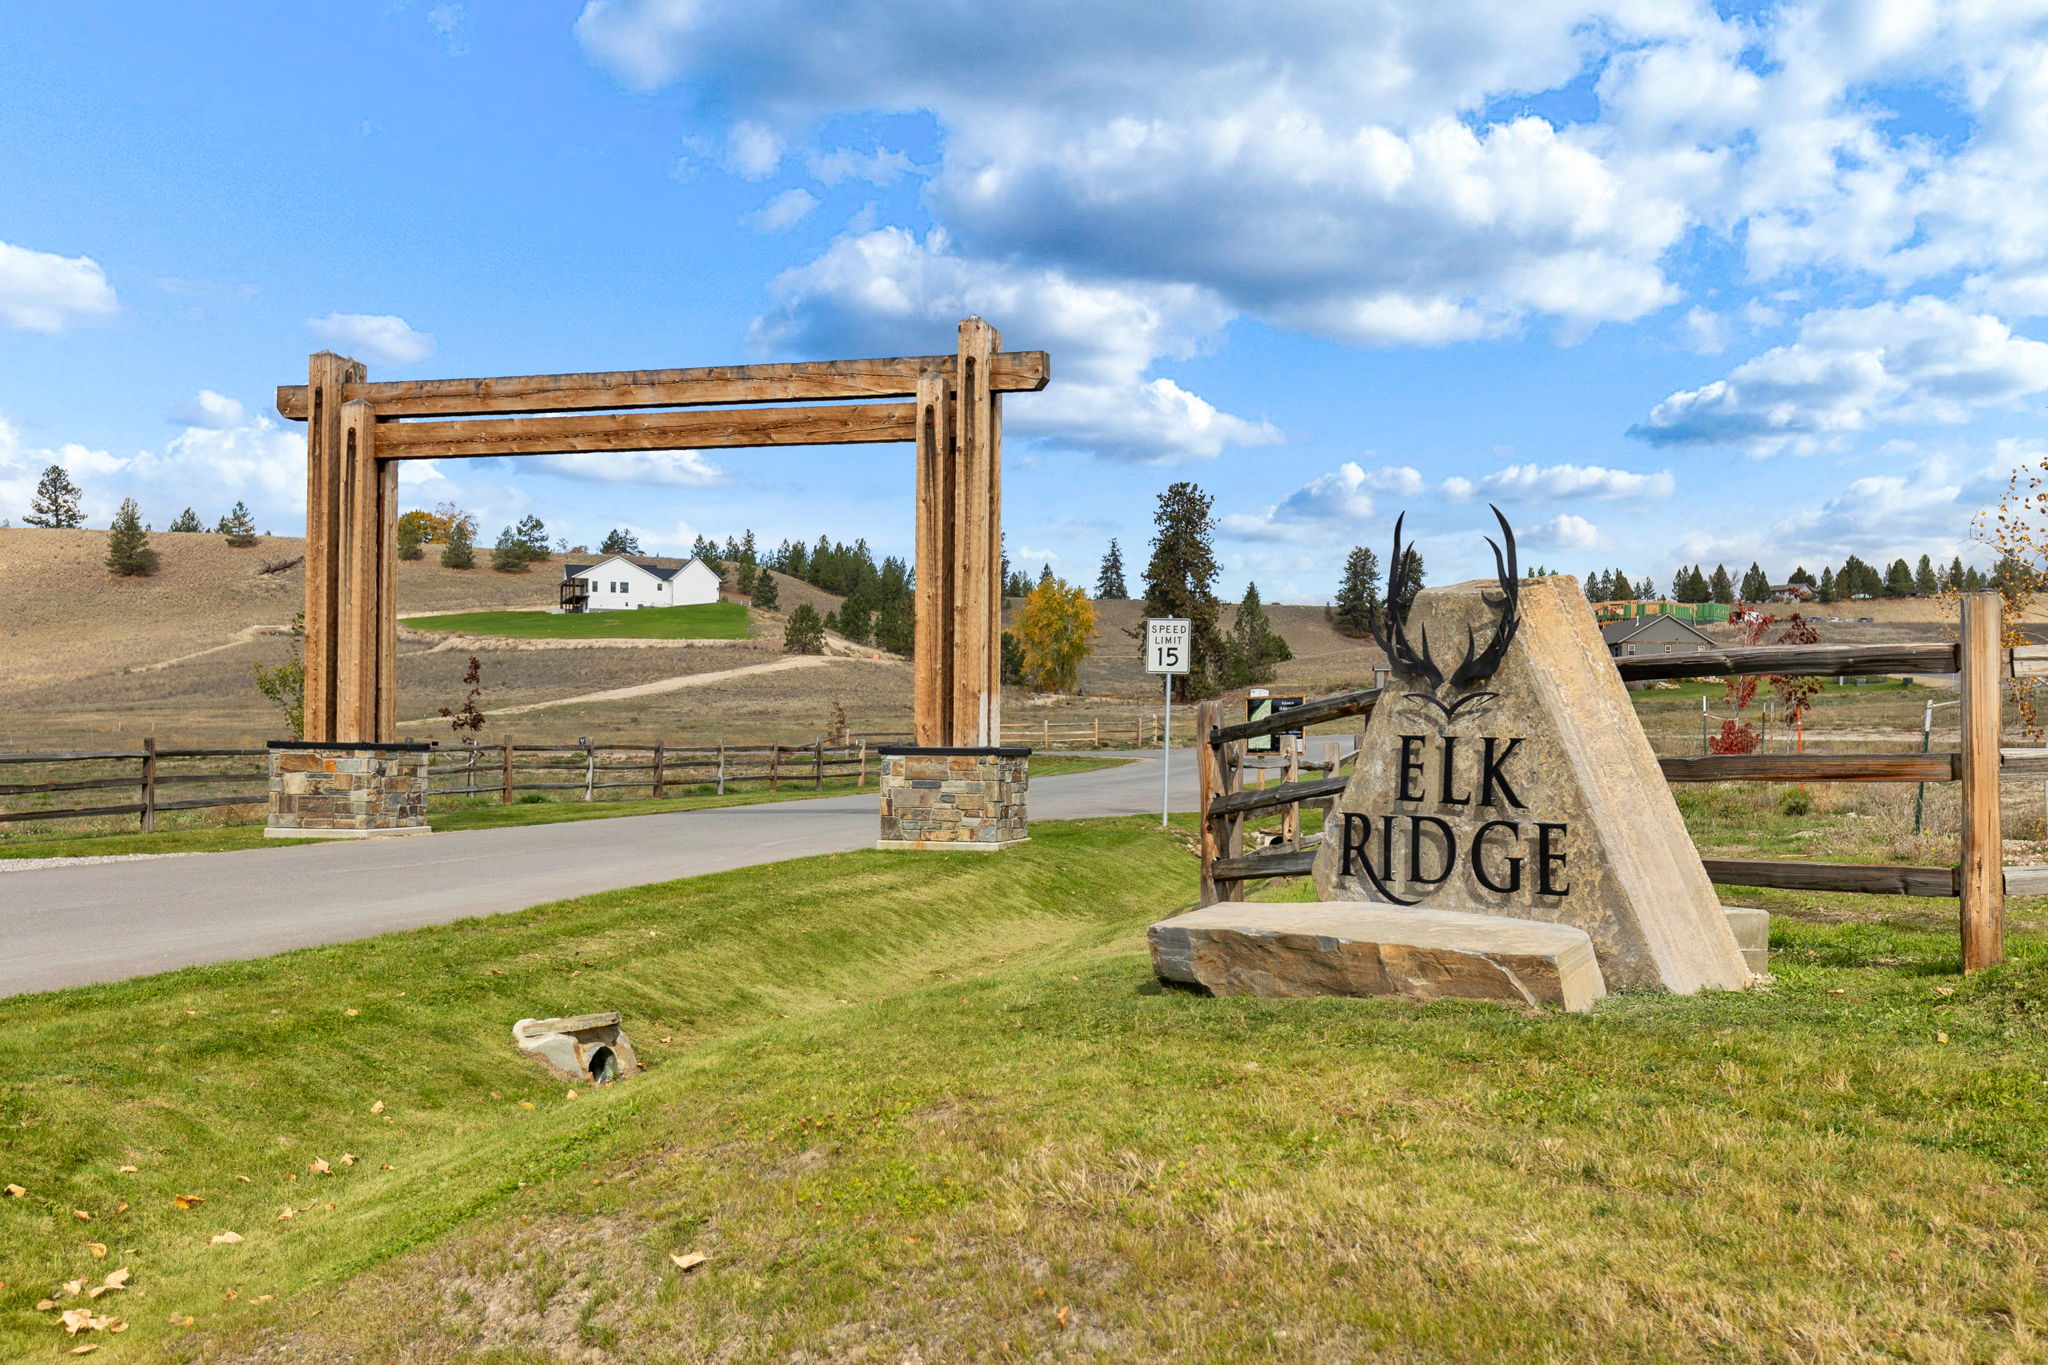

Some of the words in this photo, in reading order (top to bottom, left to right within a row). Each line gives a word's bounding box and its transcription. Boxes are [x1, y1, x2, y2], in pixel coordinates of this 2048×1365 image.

[1151, 625, 1187, 634] SPEED
[1155, 636, 1182, 645] LIMIT
[1157, 647, 1179, 667] 15
[1397, 734, 1529, 809] ELK
[1339, 812, 1571, 907] RIDGE
